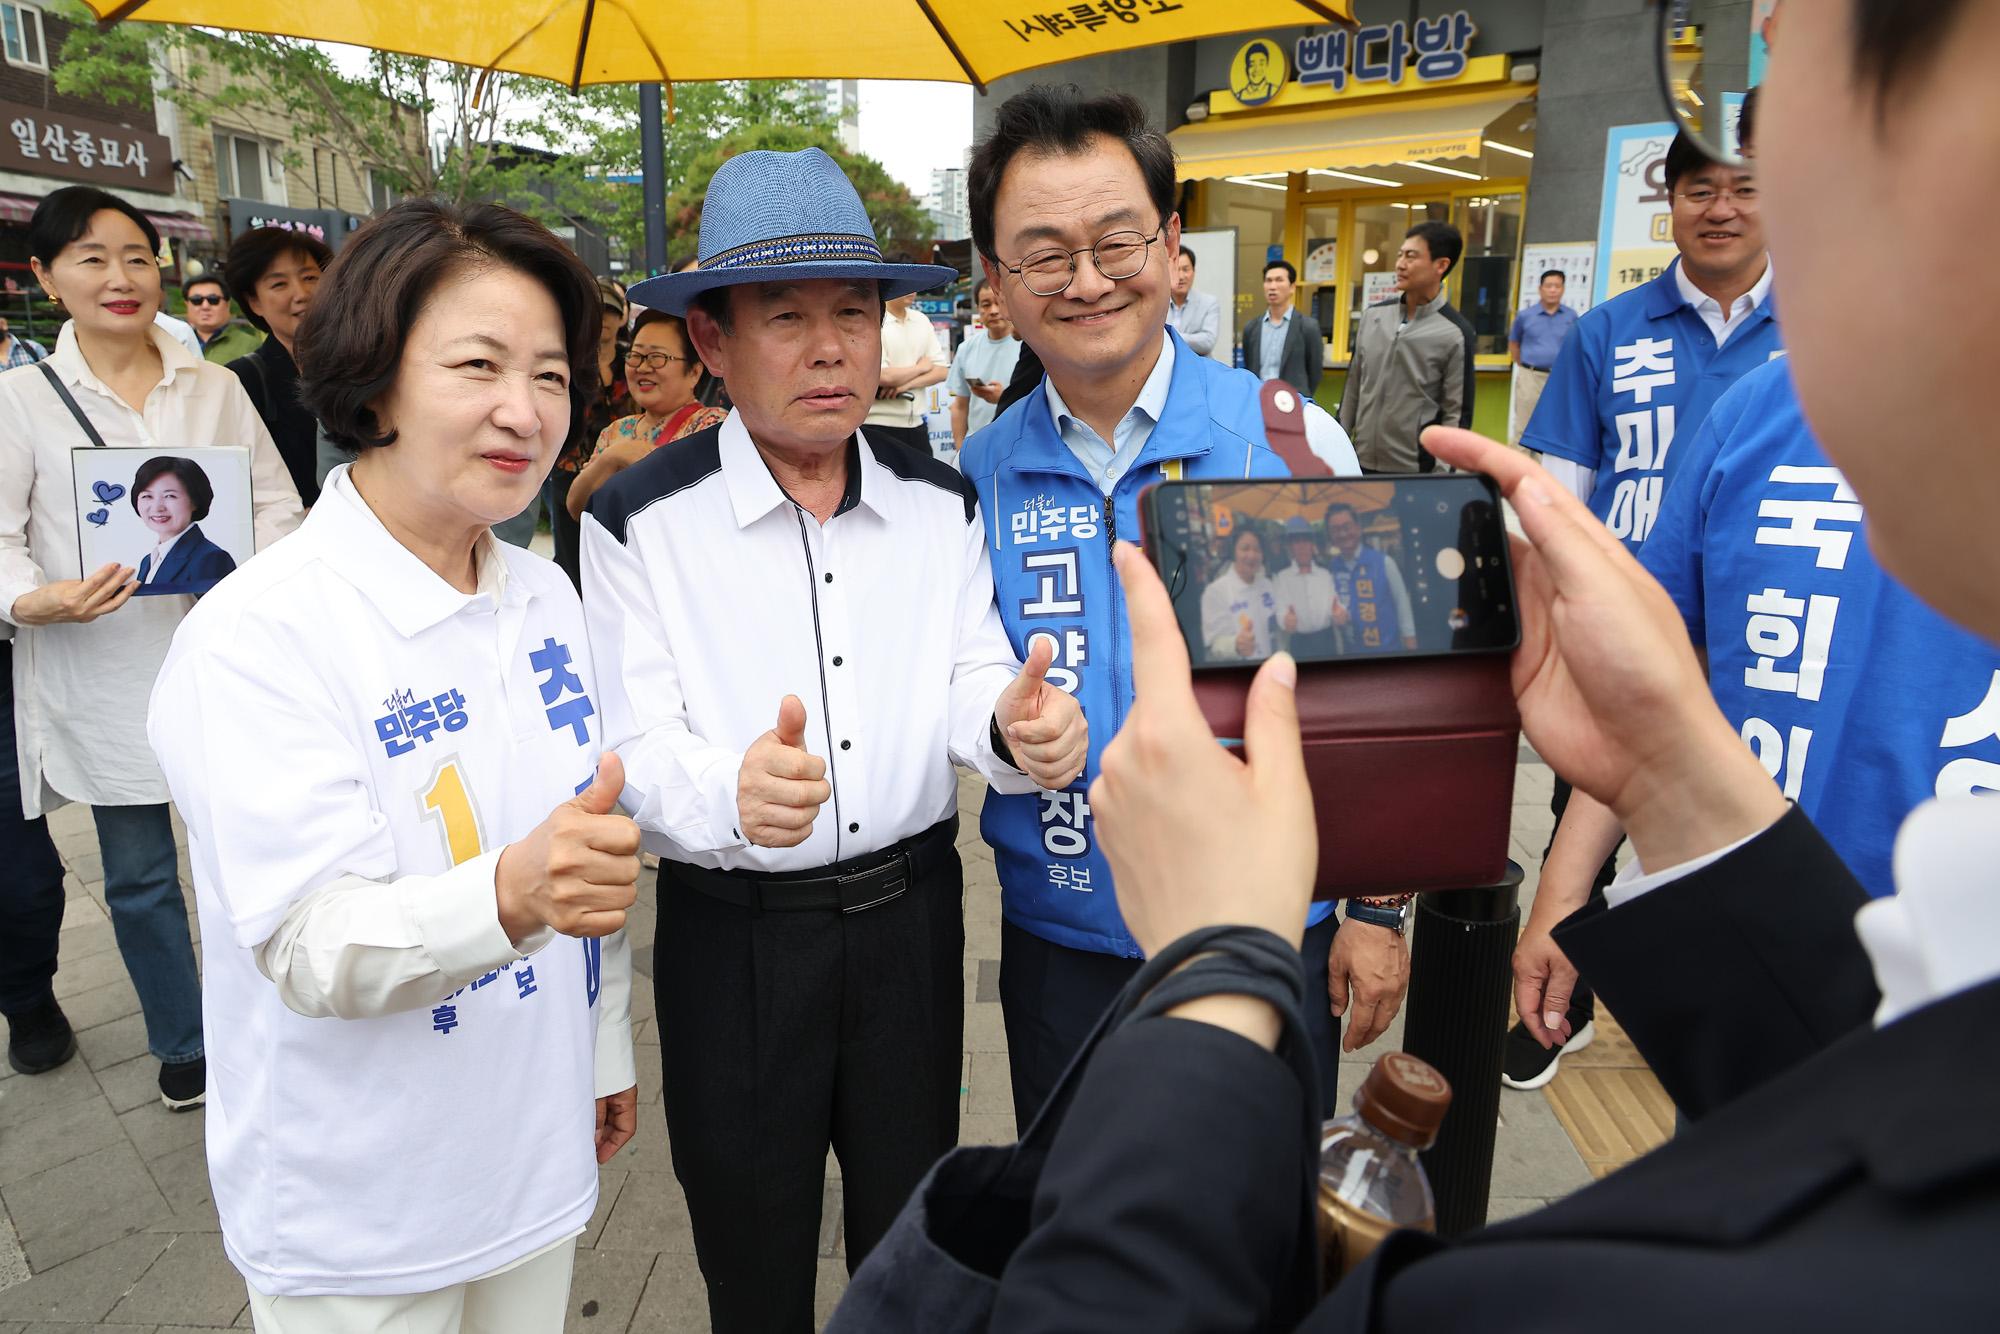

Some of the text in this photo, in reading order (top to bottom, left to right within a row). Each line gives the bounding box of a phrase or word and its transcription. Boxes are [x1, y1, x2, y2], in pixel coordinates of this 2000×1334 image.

[1296, 10, 1476, 92] 빽다방
[10, 117, 149, 178] 일산종묘사
[1436, 144, 1467, 153] COFFEE
[1605, 337, 1676, 542] 추미애
[1011, 504, 1100, 546] 민주당
[1022, 493, 1056, 513] 더불어
[374, 687, 469, 759] 민주당
[382, 687, 416, 712] 더불어
[414, 752, 489, 872] 1
[1047, 862, 1093, 893] 후보
